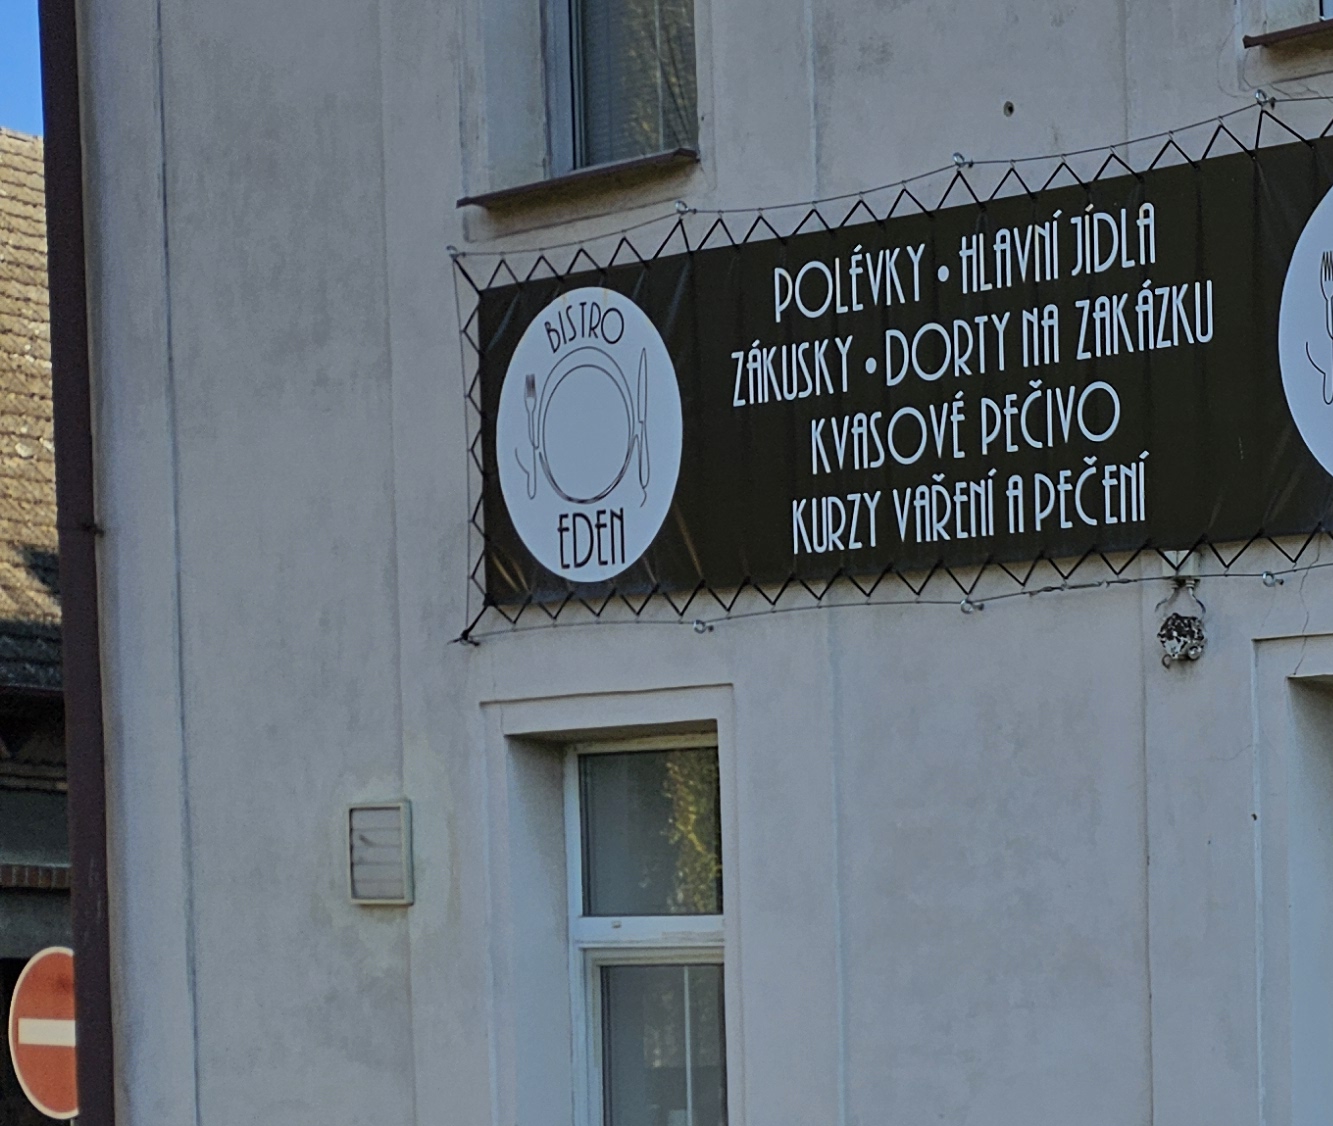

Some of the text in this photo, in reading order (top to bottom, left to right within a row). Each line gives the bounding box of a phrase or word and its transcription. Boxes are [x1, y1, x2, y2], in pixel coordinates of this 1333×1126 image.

[774, 203, 1156, 323] POLÉVKY HLAVNÍ JÍDLA
[544, 301, 625, 354] BISTRO
[731, 279, 1214, 407] ZÁKUSKY DORTY NA ZAKÁZKU
[811, 379, 1120, 475] KVASOVÉ PEČIVO
[557, 507, 626, 570] EDEN
[792, 450, 1150, 555] KURZY VAŘENÍ A PEČENÍ
